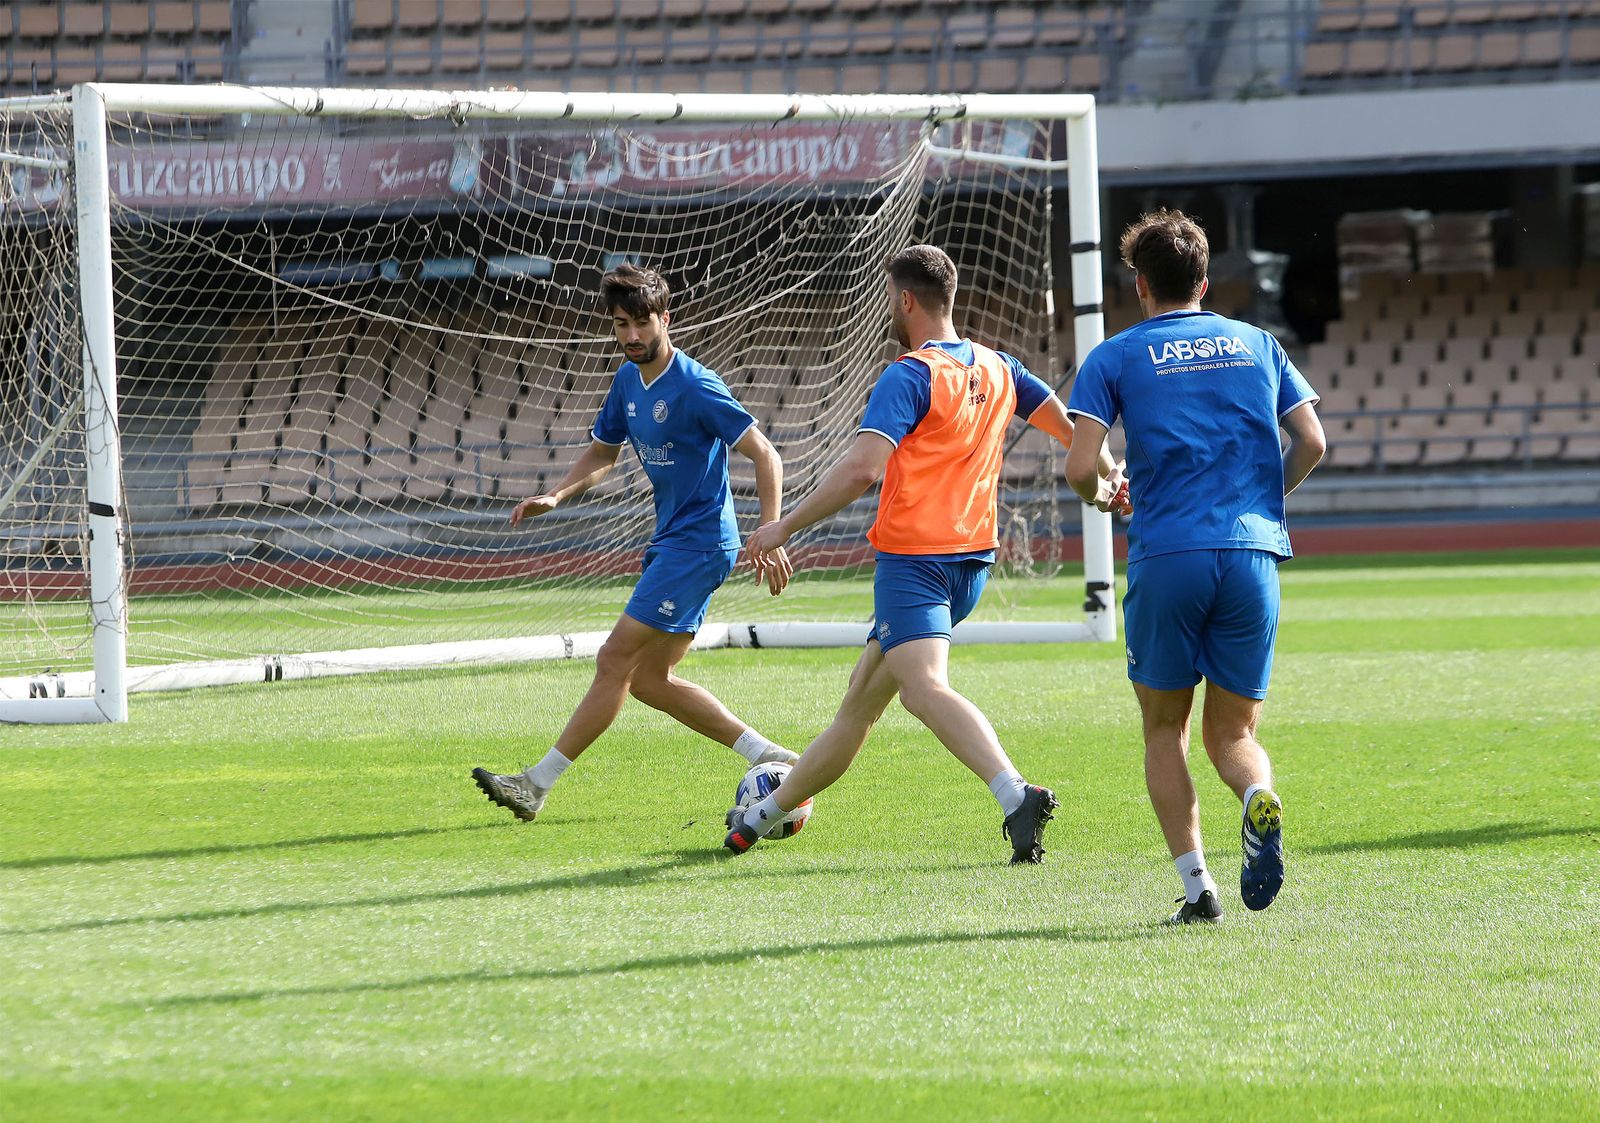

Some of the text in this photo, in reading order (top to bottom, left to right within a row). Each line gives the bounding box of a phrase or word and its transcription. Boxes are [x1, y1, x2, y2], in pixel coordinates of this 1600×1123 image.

[628, 134, 859, 180] Cruzcampo
[1148, 336, 1253, 365] LABORA
[1156, 365, 1189, 376] PROYECTOS
[1189, 362, 1224, 372] INTEGRALES
